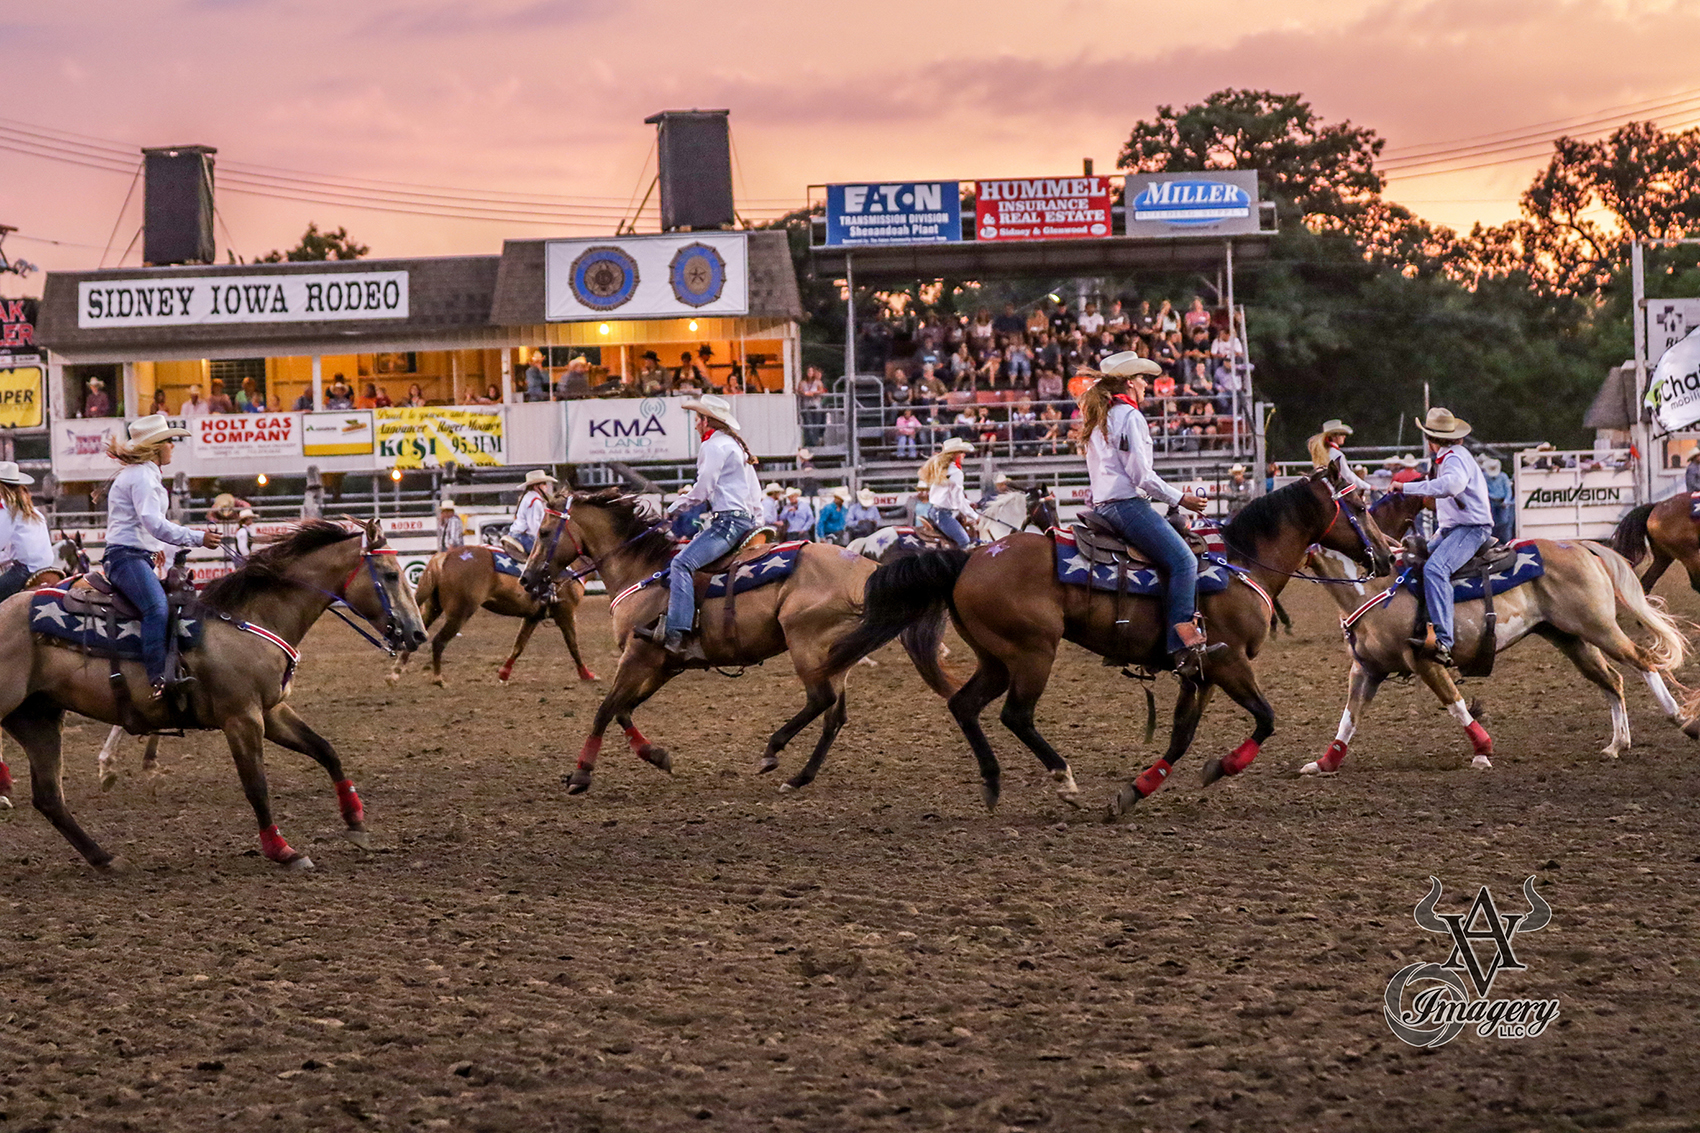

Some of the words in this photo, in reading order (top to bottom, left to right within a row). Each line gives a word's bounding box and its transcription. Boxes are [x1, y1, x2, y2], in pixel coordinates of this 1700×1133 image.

[980, 178, 1106, 200] HUMMEL
[1143, 181, 1239, 205] MILLER
[844, 184, 942, 213] EATON
[998, 198, 1089, 212] INSURANCE
[839, 213, 907, 226] TRANSMISSION
[908, 212, 949, 224] DIVISION
[982, 213, 996, 225] &
[999, 212, 1041, 224] REAL
[1044, 209, 1106, 222] ESTATE
[849, 224, 910, 237] Shenandoah
[911, 223, 939, 235] Plant
[999, 227, 1031, 236] Sidney
[1032, 226, 1041, 235] &
[88, 286, 195, 318] SIDNEY
[210, 283, 288, 314] IOWA
[305, 280, 400, 312] RODEO
[1661, 363, 1700, 402] Cha
[201, 418, 249, 431] HOLT
[255, 417, 292, 430] GAS
[589, 414, 667, 437] KMA
[202, 429, 291, 444] COMPANY
[605, 438, 652, 447] LAND
[380, 437, 437, 460] KCSI
